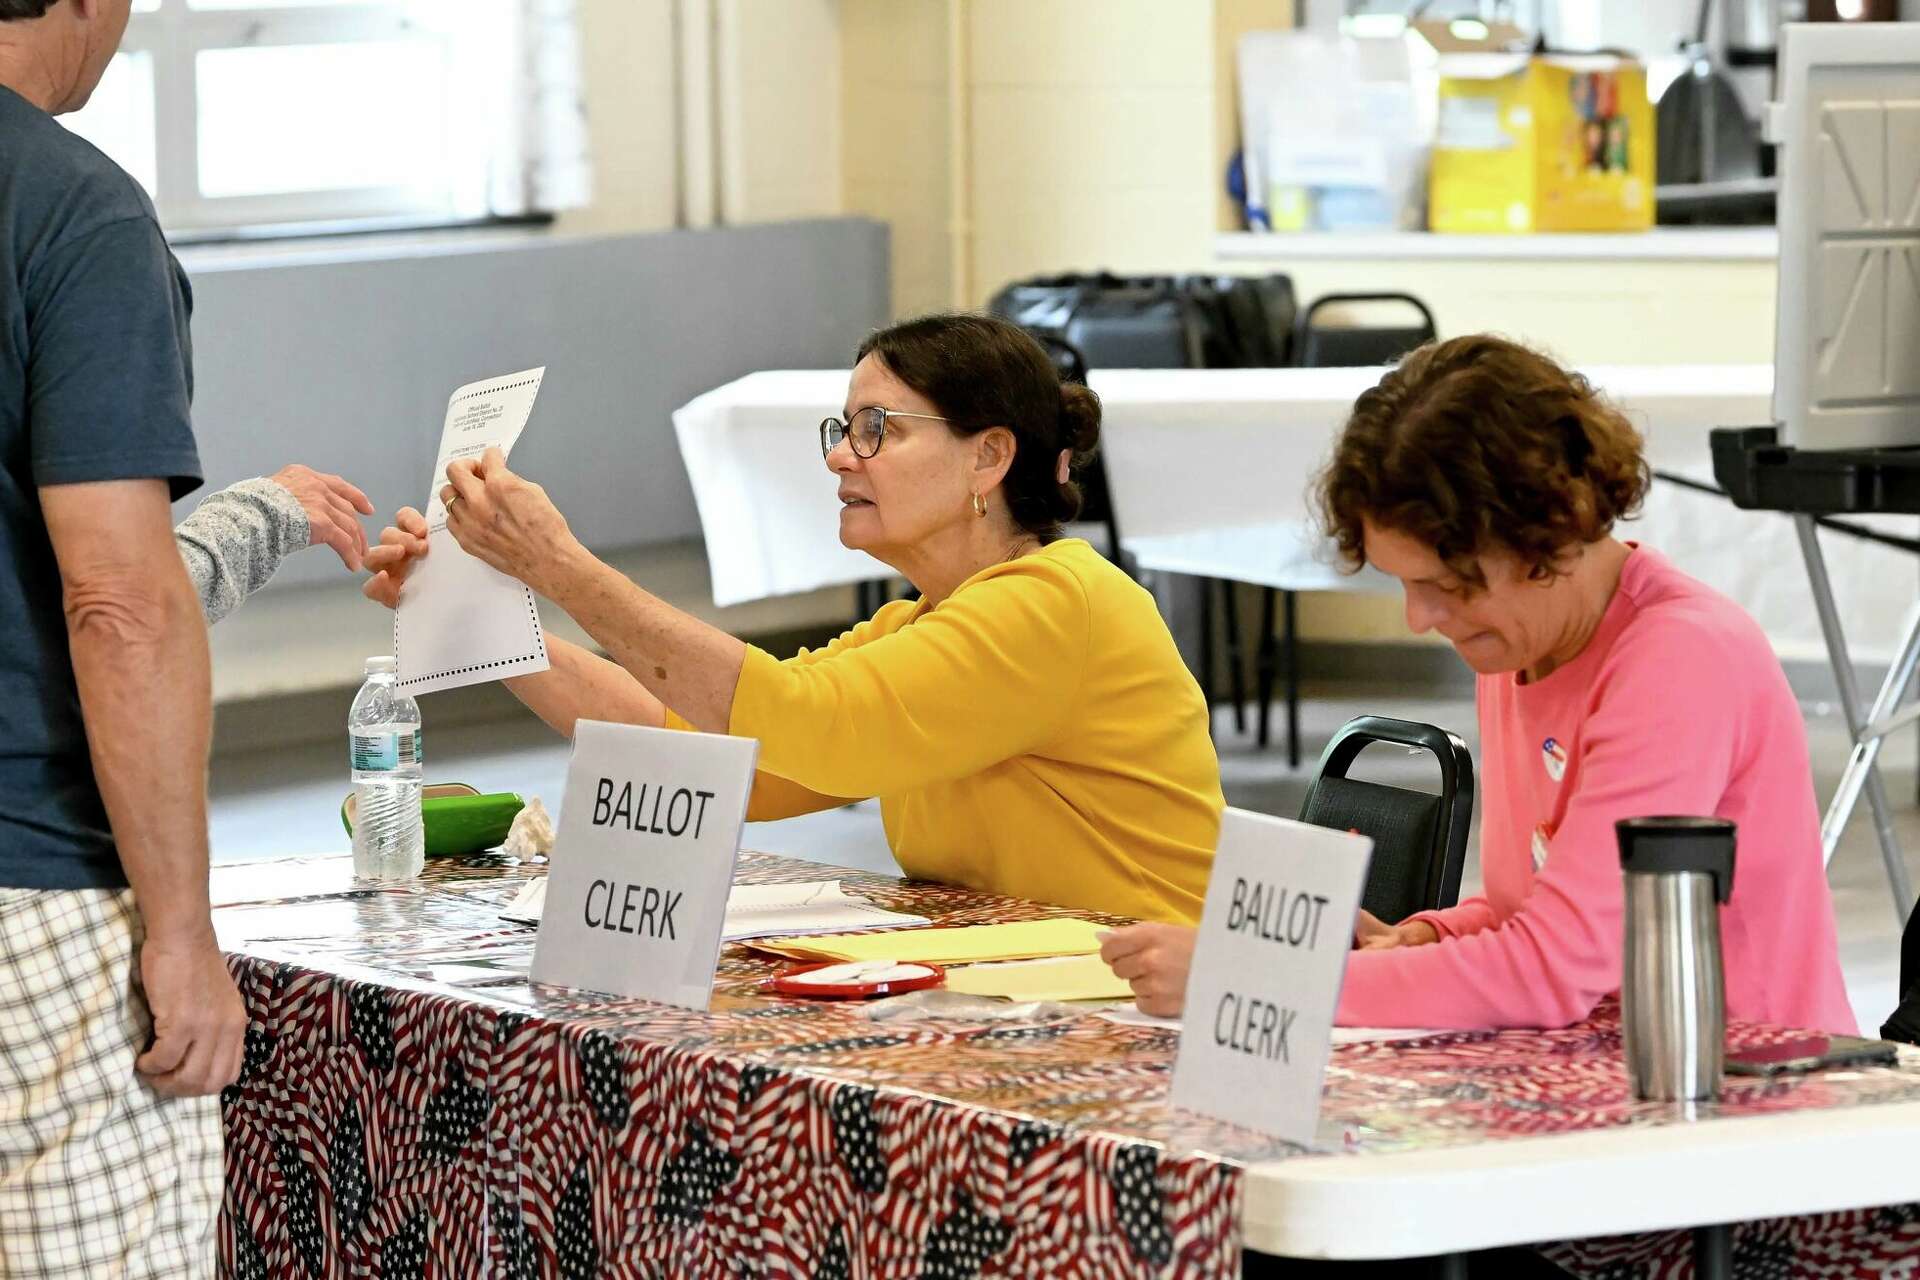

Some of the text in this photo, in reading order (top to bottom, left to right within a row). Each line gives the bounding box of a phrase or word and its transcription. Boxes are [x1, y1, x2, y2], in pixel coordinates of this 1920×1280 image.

[592, 777, 715, 840] BALLOT
[584, 879, 683, 941] CLERK
[1227, 877, 1331, 951] BALLOT
[1214, 992, 1297, 1065] CLERK
